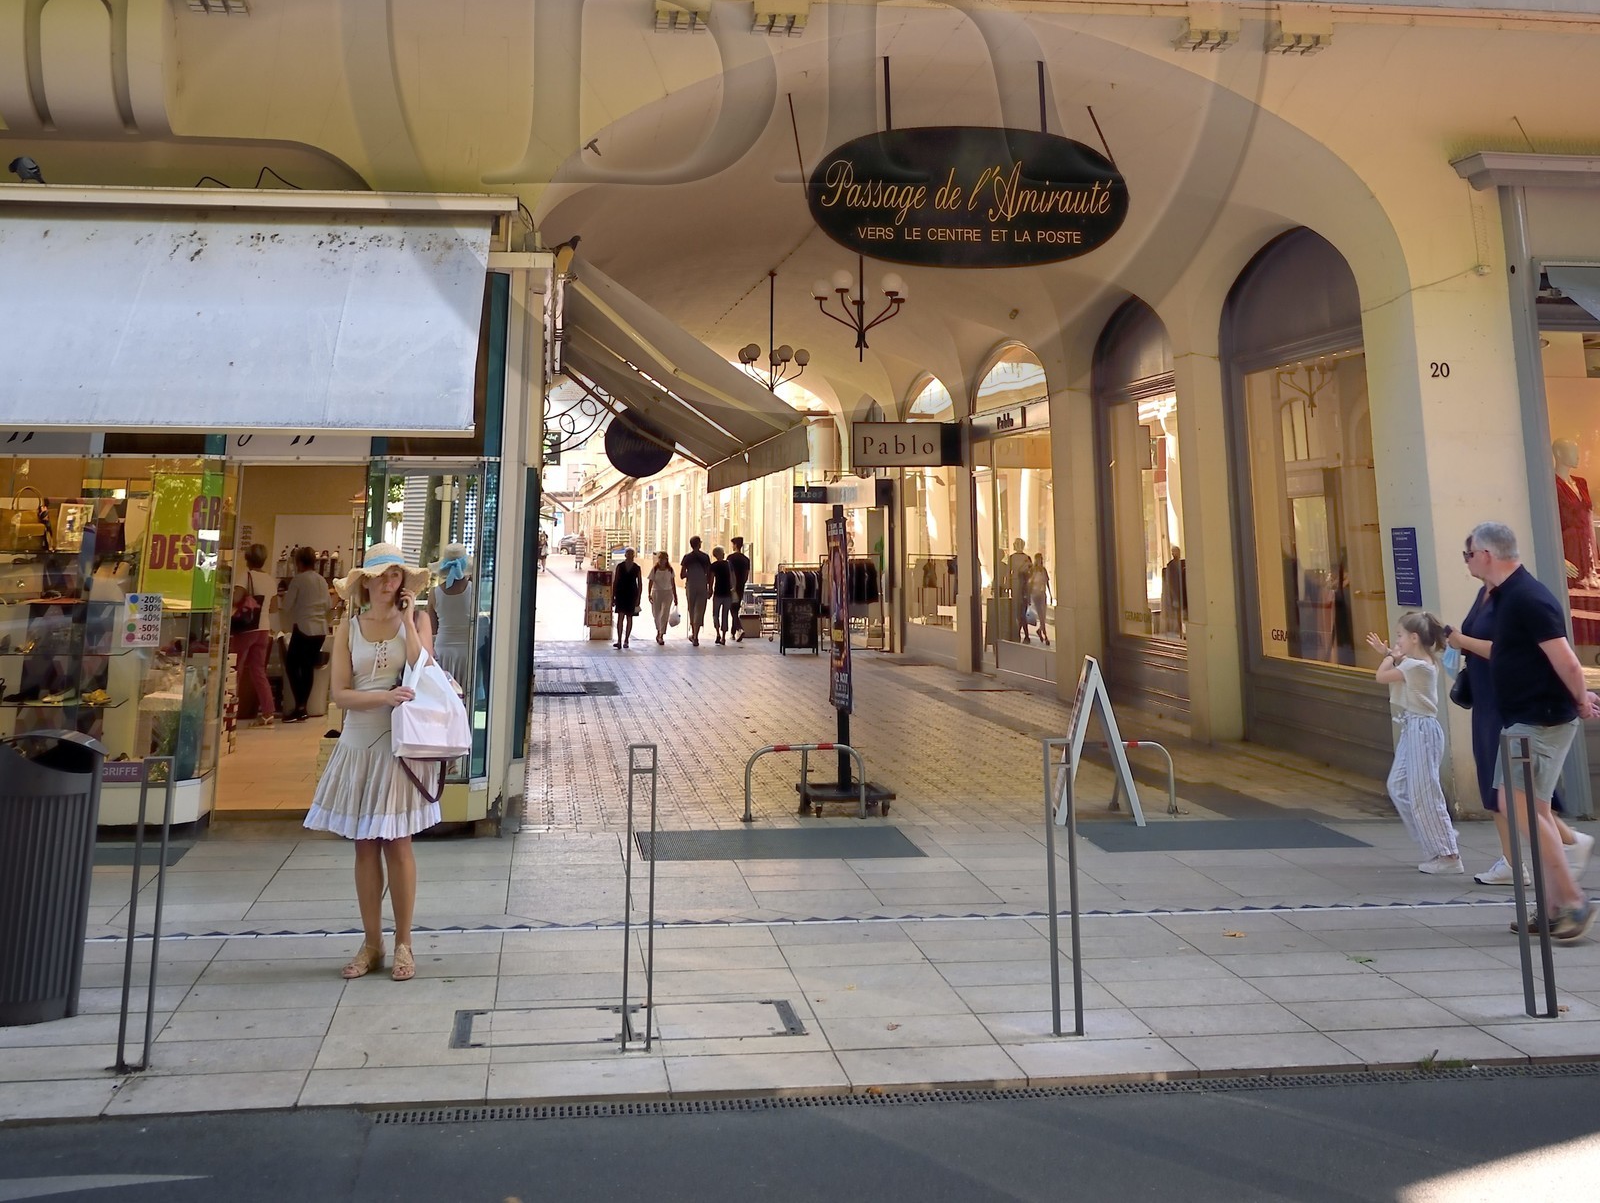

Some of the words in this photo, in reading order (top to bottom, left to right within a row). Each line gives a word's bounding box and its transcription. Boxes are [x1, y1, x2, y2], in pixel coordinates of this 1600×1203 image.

[821, 159, 927, 225] Passage
[934, 167, 962, 211] de
[967, 160, 1112, 222] l'Amirauté
[857, 226, 894, 240] VERS
[904, 227, 921, 241] LE
[927, 228, 982, 242] CENTRE
[991, 229, 1008, 242] ET
[1014, 230, 1031, 243] LA
[1037, 230, 1081, 244] POSTE
[1430, 362, 1450, 378] 20
[862, 435, 934, 455] Pablo
[141, 596, 162, 604] -20%
[140, 604, 161, 613] -30%
[139, 614, 160, 622] -40%
[138, 624, 160, 633] -50%
[137, 633, 159, 642] -60%
[103, 766, 138, 776] GRIFFE
